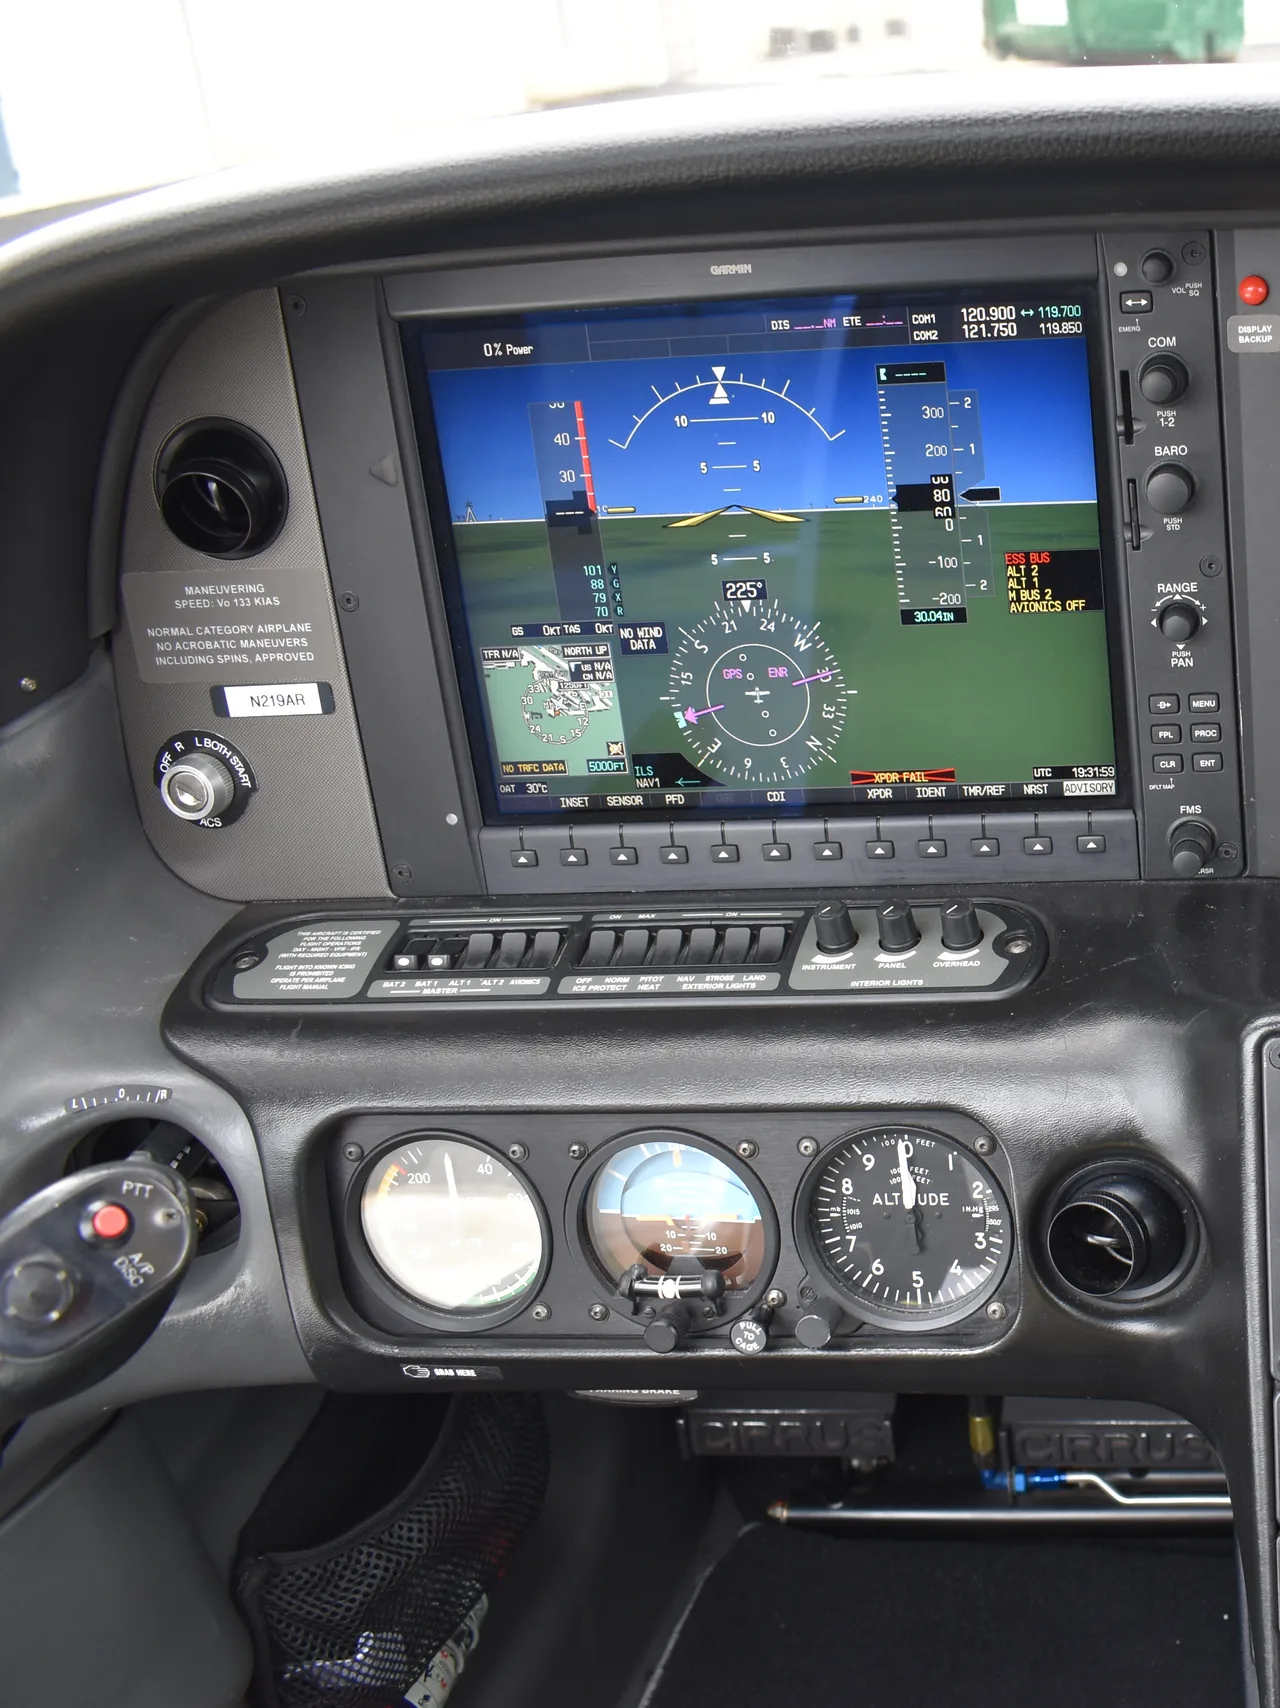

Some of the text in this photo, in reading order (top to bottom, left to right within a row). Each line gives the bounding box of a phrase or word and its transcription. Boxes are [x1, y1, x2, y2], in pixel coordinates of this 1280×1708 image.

[710, 264, 752, 275] GARMIN
[912, 305, 1081, 324] COM1 120.900 119.700
[843, 316, 862, 326] ETE
[913, 322, 1082, 340] COM2 121.750 119.850
[1238, 325, 1272, 334] DISPLAY
[1148, 337, 1176, 347] COM
[1238, 334, 1272, 344] BACKUP
[506, 343, 533, 356] Power
[922, 406, 944, 419] 300
[1159, 417, 1175, 427] 1-2
[554, 433, 570, 445] 40
[925, 444, 948, 457] 200
[1154, 446, 1188, 456] BARO
[1005, 552, 1050, 564] ESS BUS
[185, 584, 264, 596] MANEUVERING
[1157, 583, 1198, 593] RANGE
[175, 599, 214, 608] SPEED:
[233, 597, 251, 606] 133
[254, 596, 280, 606] KIAS
[1010, 600, 1085, 612] AVIONICS OFF
[147, 622, 312, 637] NORMAL CATEGORY AIRPLANE
[620, 626, 663, 639] NO WIND
[156, 638, 308, 651] NO ACROBATIC MANEUVERS
[630, 638, 656, 650] DATA
[156, 652, 314, 666] INCLUDING SPINS, APPROVED
[250, 694, 306, 708] N219AR
[1192, 700, 1216, 708] MENU
[1194, 729, 1217, 738] PROC
[230, 756, 252, 788] START
[1034, 766, 1115, 777] UTC 19:31:59
[867, 788, 893, 799] XPDR
[916, 786, 946, 797] IDENT
[962, 785, 1006, 796] TMR/REF
[1023, 783, 1048, 794] NRST
[1064, 782, 1115, 794] ADVISORY
[560, 797, 590, 807] INSET
[606, 795, 644, 806] SENSOR
[665, 794, 685, 804] PFD
[767, 791, 786, 801] CDI
[1180, 805, 1202, 814] FMS
[862, 1154, 875, 1171] 9
[477, 1163, 493, 1175] 40
[407, 1173, 431, 1184] 200
[122, 1180, 154, 1197] PTT
[740, 1321, 761, 1335] PULL
[744, 1331, 754, 1340] TO
[735, 1338, 760, 1351] CAGE
